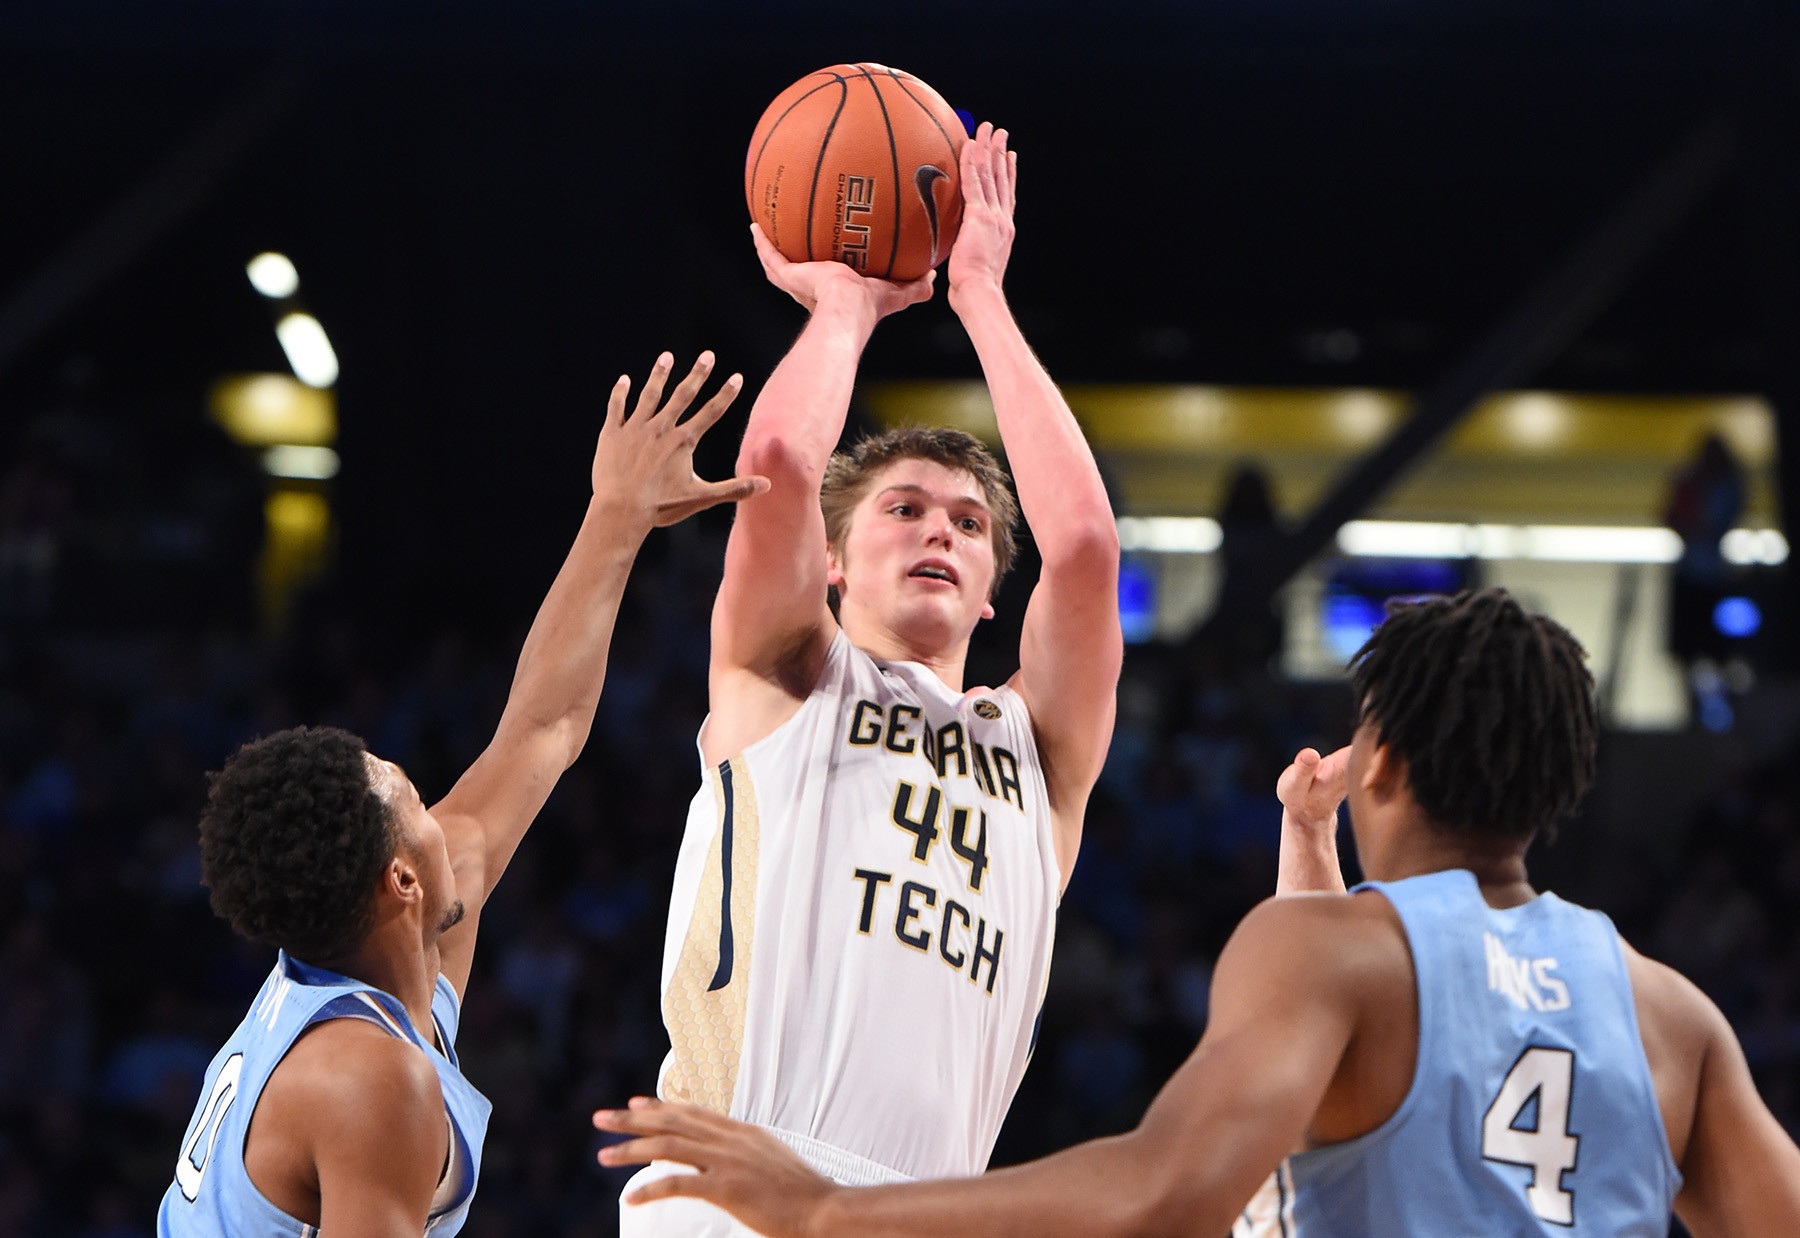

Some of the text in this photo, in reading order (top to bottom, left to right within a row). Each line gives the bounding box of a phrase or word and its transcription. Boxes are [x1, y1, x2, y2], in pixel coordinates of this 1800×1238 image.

[848, 699, 1025, 815] GEORIA
[890, 778, 990, 894] 44
[852, 866, 1005, 998] TECH
[175, 1051, 244, 1205] 0
[1480, 1045, 1580, 1228] 4
